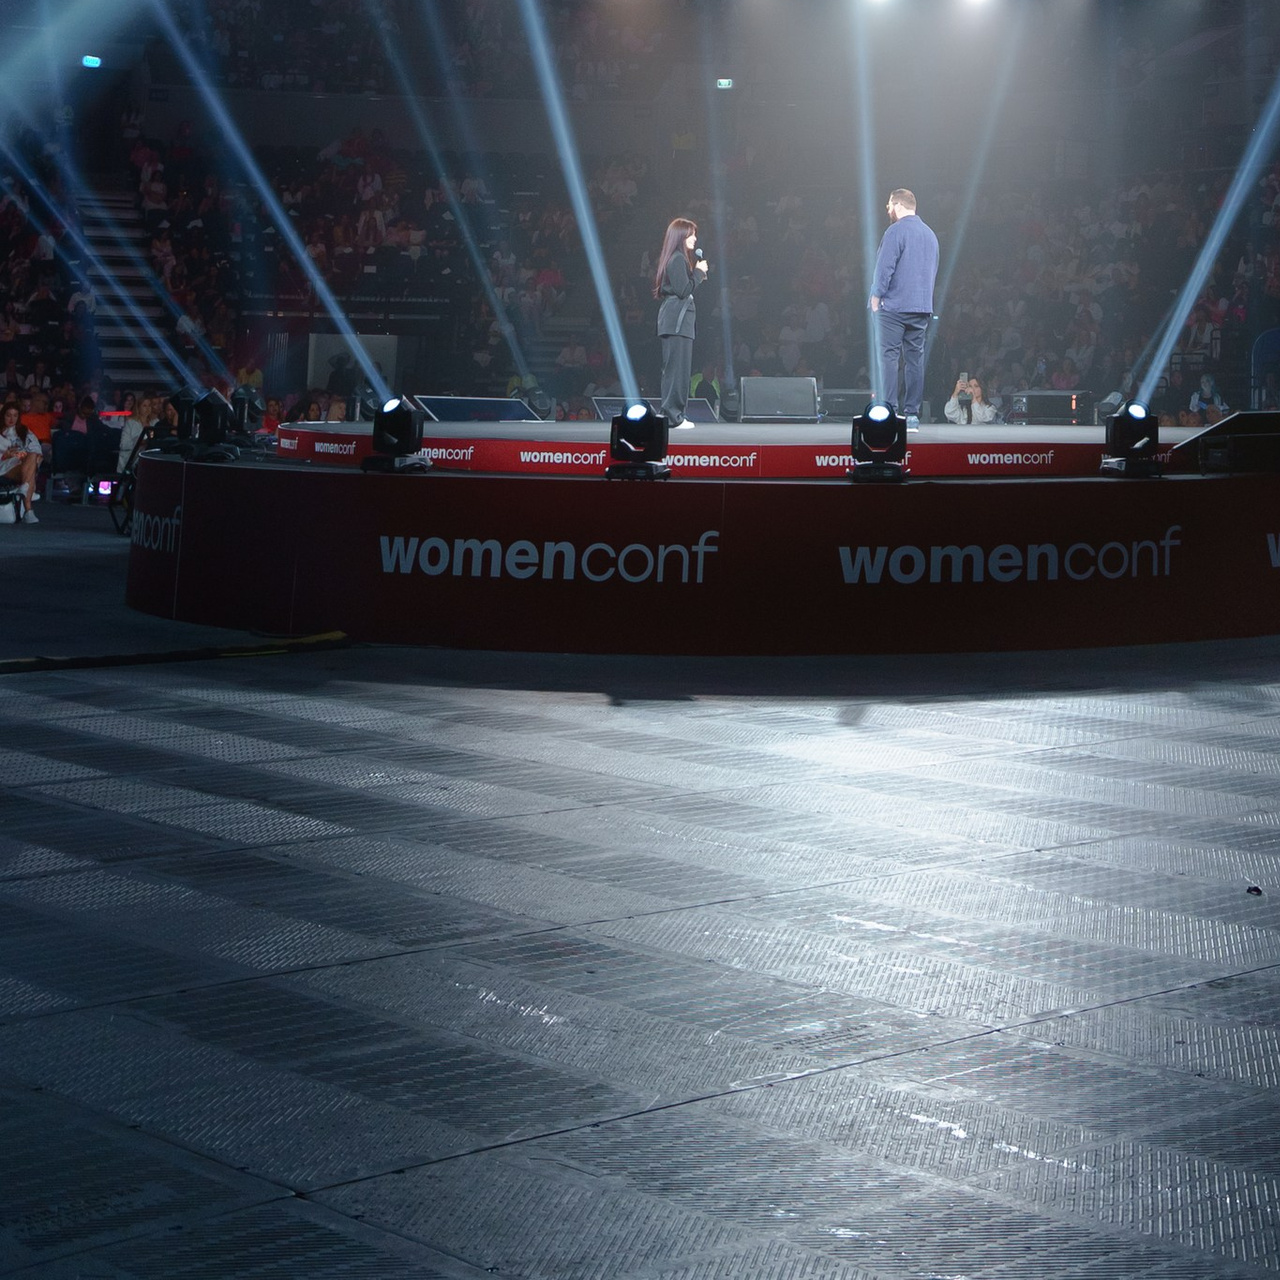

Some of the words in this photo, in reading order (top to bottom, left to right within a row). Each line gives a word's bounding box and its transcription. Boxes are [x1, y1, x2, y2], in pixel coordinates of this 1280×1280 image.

[314, 440, 356, 456] womenconf
[420, 446, 475, 461] menconf
[520, 449, 607, 466] womenconf
[662, 452, 757, 468] womenconf
[967, 450, 1054, 465] womenconf
[379, 530, 720, 584] womenconf
[838, 524, 1182, 585] womenconf
